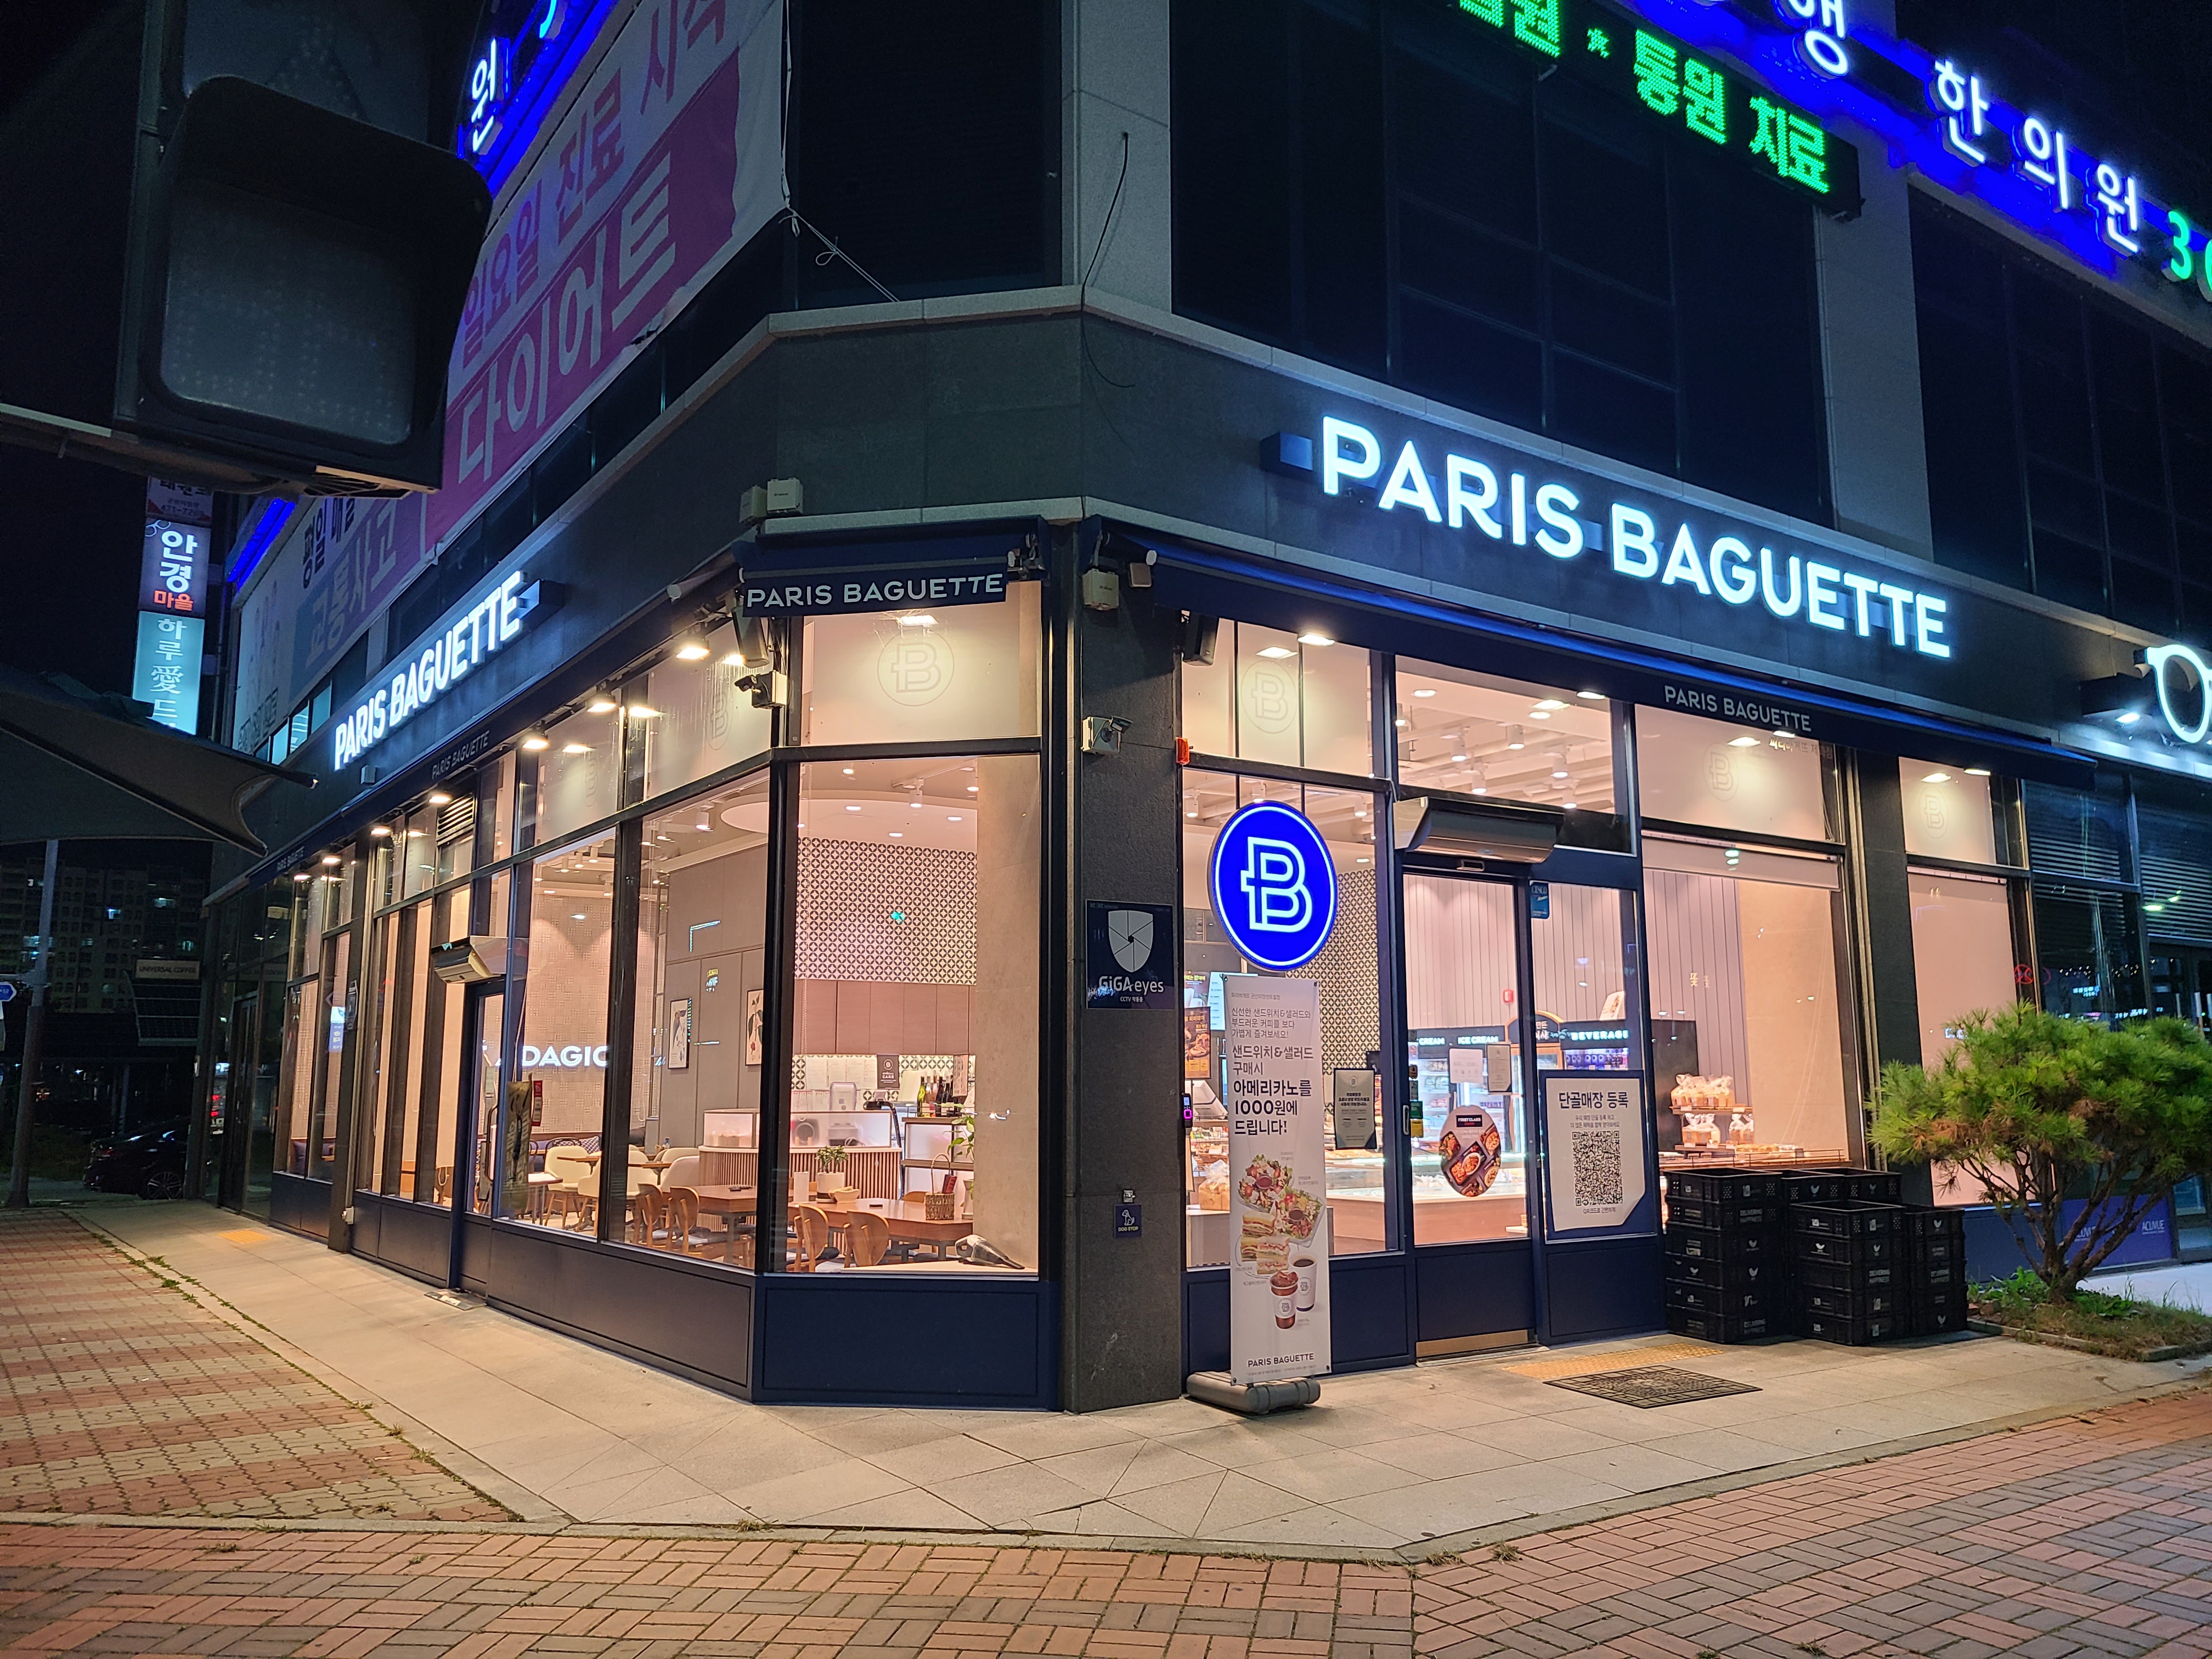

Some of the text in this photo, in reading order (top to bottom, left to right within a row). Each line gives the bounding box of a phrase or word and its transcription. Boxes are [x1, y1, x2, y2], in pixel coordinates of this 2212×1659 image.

[1633, 29, 1727, 145] 통원
[1749, 96, 1830, 193] 치료
[555, 67, 627, 248] 진료
[1932, 58, 2140, 255] 한의원
[458, 151, 676, 485] 다이어트
[1323, 415, 1951, 658] PARIS BAGUETTE
[159, 529, 199, 594] 안경
[747, 573, 1003, 608] PARIS BAGUETTE
[154, 589, 194, 612] 마을
[334, 689, 387, 772] PARIS
[388, 569, 526, 727] BAGUETTE
[1664, 685, 1812, 733] PARIS BAGUETTE
[432, 729, 490, 780] PARIS BAGUETTE
[1099, 975, 1164, 995] GiGA eyes
[1232, 1018, 1295, 1029] 부드러운 커피를 보다
[1254, 1009, 1311, 1019] 샌드위치&샐러드와
[1232, 1029, 1289, 1039] 가볍게 즐겨보세요!
[1419, 1037, 1445, 1046] CREAM
[1458, 1036, 1499, 1045] ICE CREAM
[1233, 1045, 1313, 1059] 샌드위치&샐러드
[1233, 1062, 1263, 1075] 구매시
[1233, 1079, 1312, 1097] 아메리카노를
[1235, 1099, 1298, 1116] 1000원에
[1559, 1092, 1628, 1109] 단골매장 등록
[1234, 1119, 1287, 1136] 드립니다!
[1248, 1353, 1314, 1367] PARIS BAGUETTE
